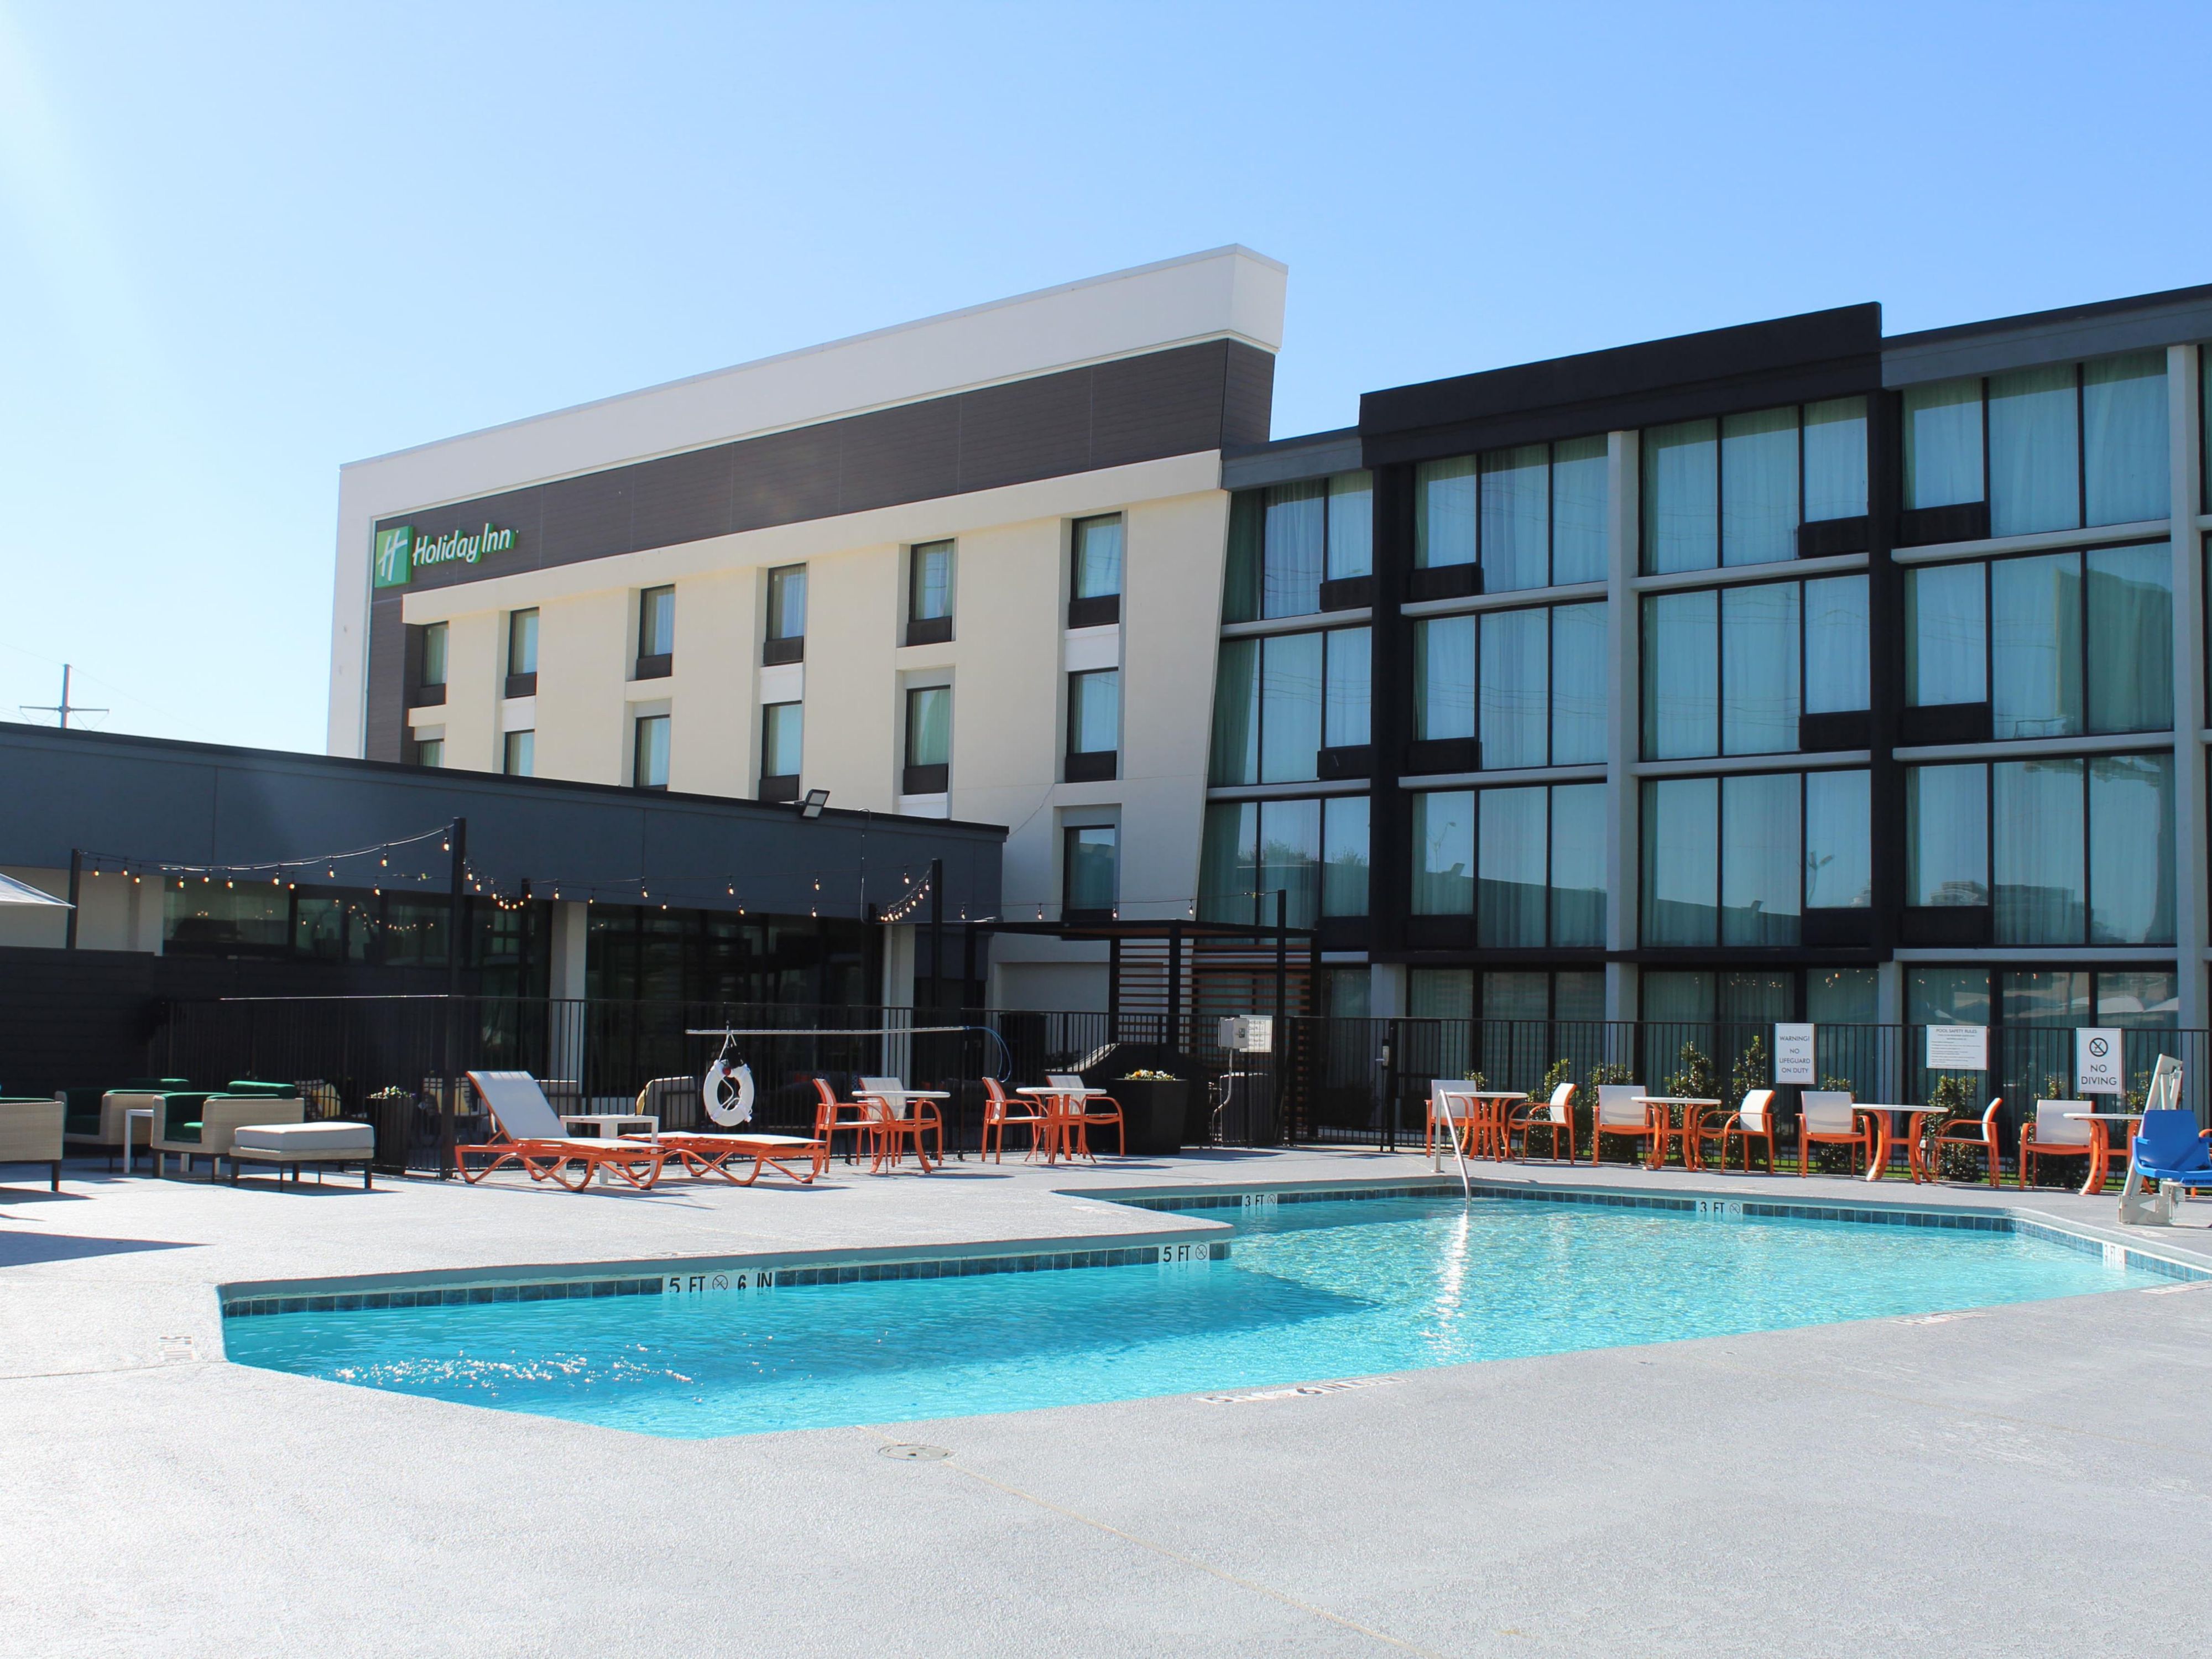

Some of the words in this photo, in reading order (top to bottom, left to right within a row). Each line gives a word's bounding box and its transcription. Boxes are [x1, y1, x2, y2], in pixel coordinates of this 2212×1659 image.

[413, 530, 480, 564] Holiday
[482, 523, 511, 554] Inn
[2081, 1076, 2117, 1085] DIVING
[1245, 1195, 1250, 1207] 3
[1255, 1194, 1264, 1206] FT
[1700, 1201, 1707, 1212] 3
[1714, 1202, 1725, 1213] FT
[1163, 1246, 1171, 1262] 5
[1178, 1245, 1191, 1262] FT
[669, 1277, 680, 1293] 5
[689, 1276, 706, 1292] FT
[738, 1274, 746, 1290] 6
[757, 1272, 773, 1288] IN
